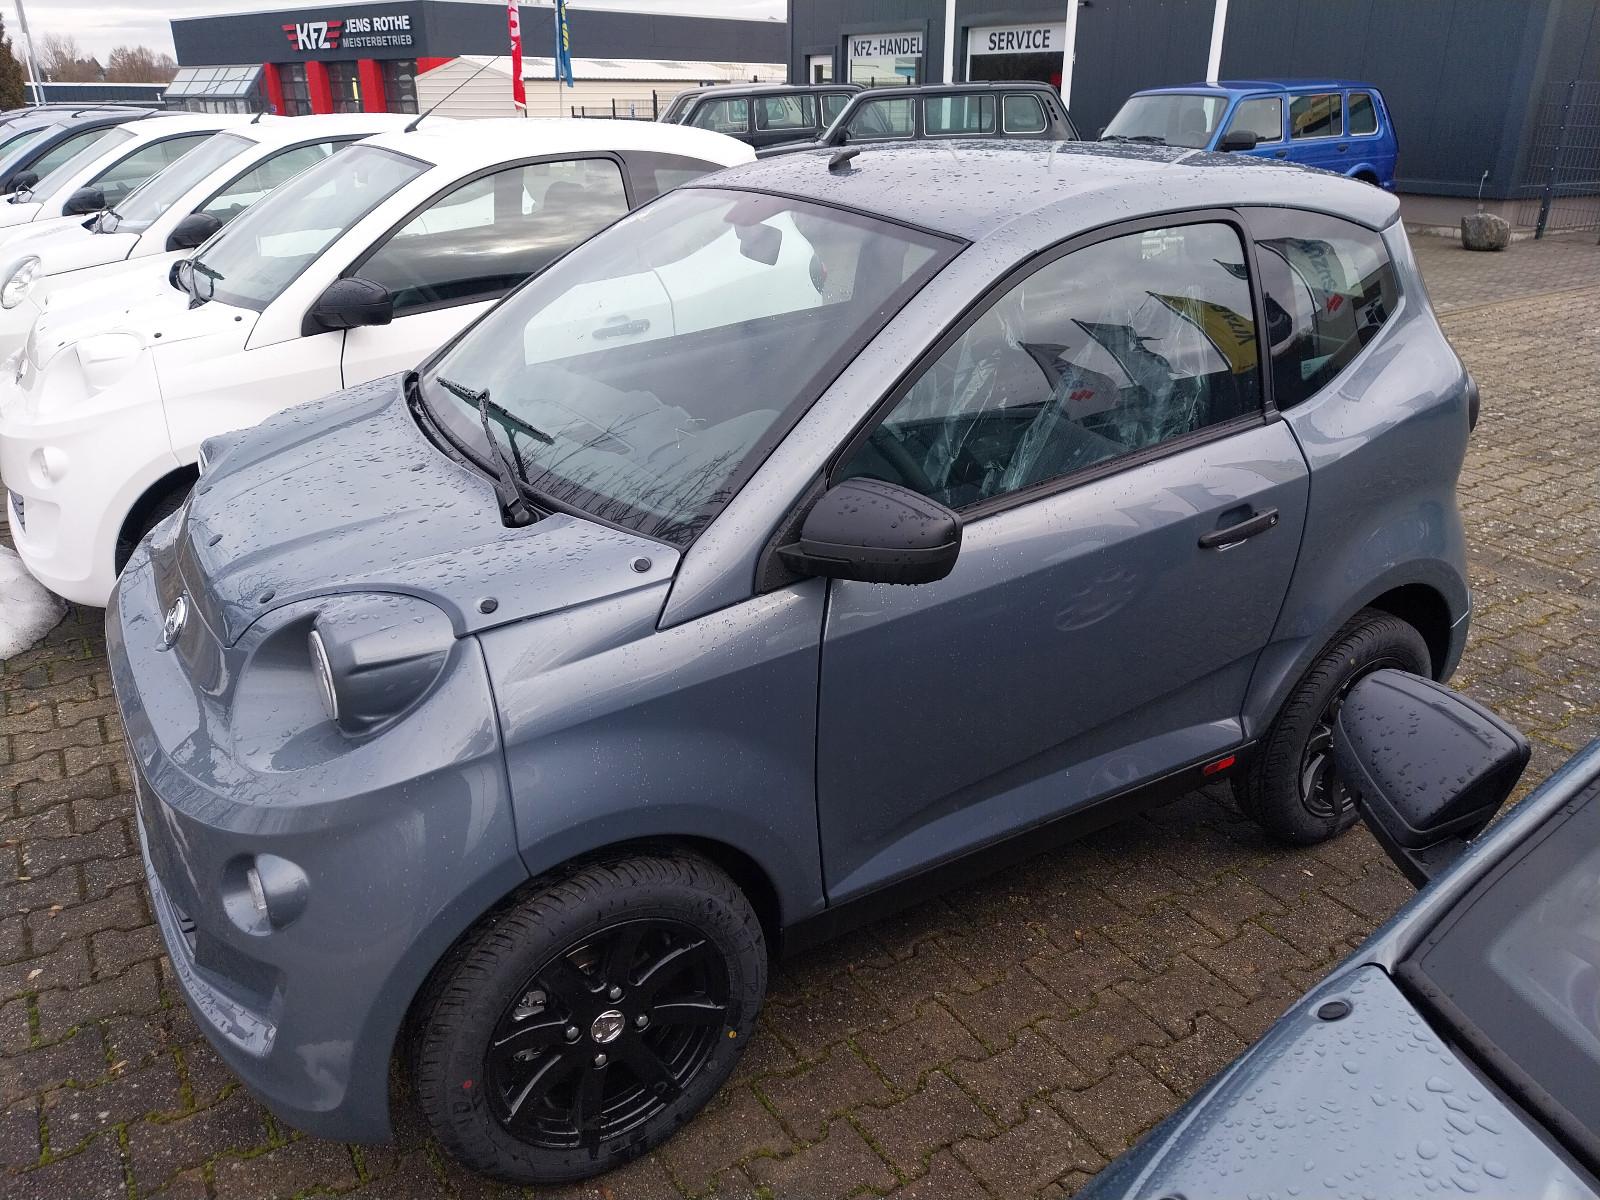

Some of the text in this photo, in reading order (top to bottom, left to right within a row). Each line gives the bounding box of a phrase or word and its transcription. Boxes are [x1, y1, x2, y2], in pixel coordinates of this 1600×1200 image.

[345, 15, 410, 33] JENS ROTHE
[295, 22, 331, 50] KFZ
[342, 34, 412, 48] MEISTERBETRIEB
[988, 29, 1051, 51] SERVICE
